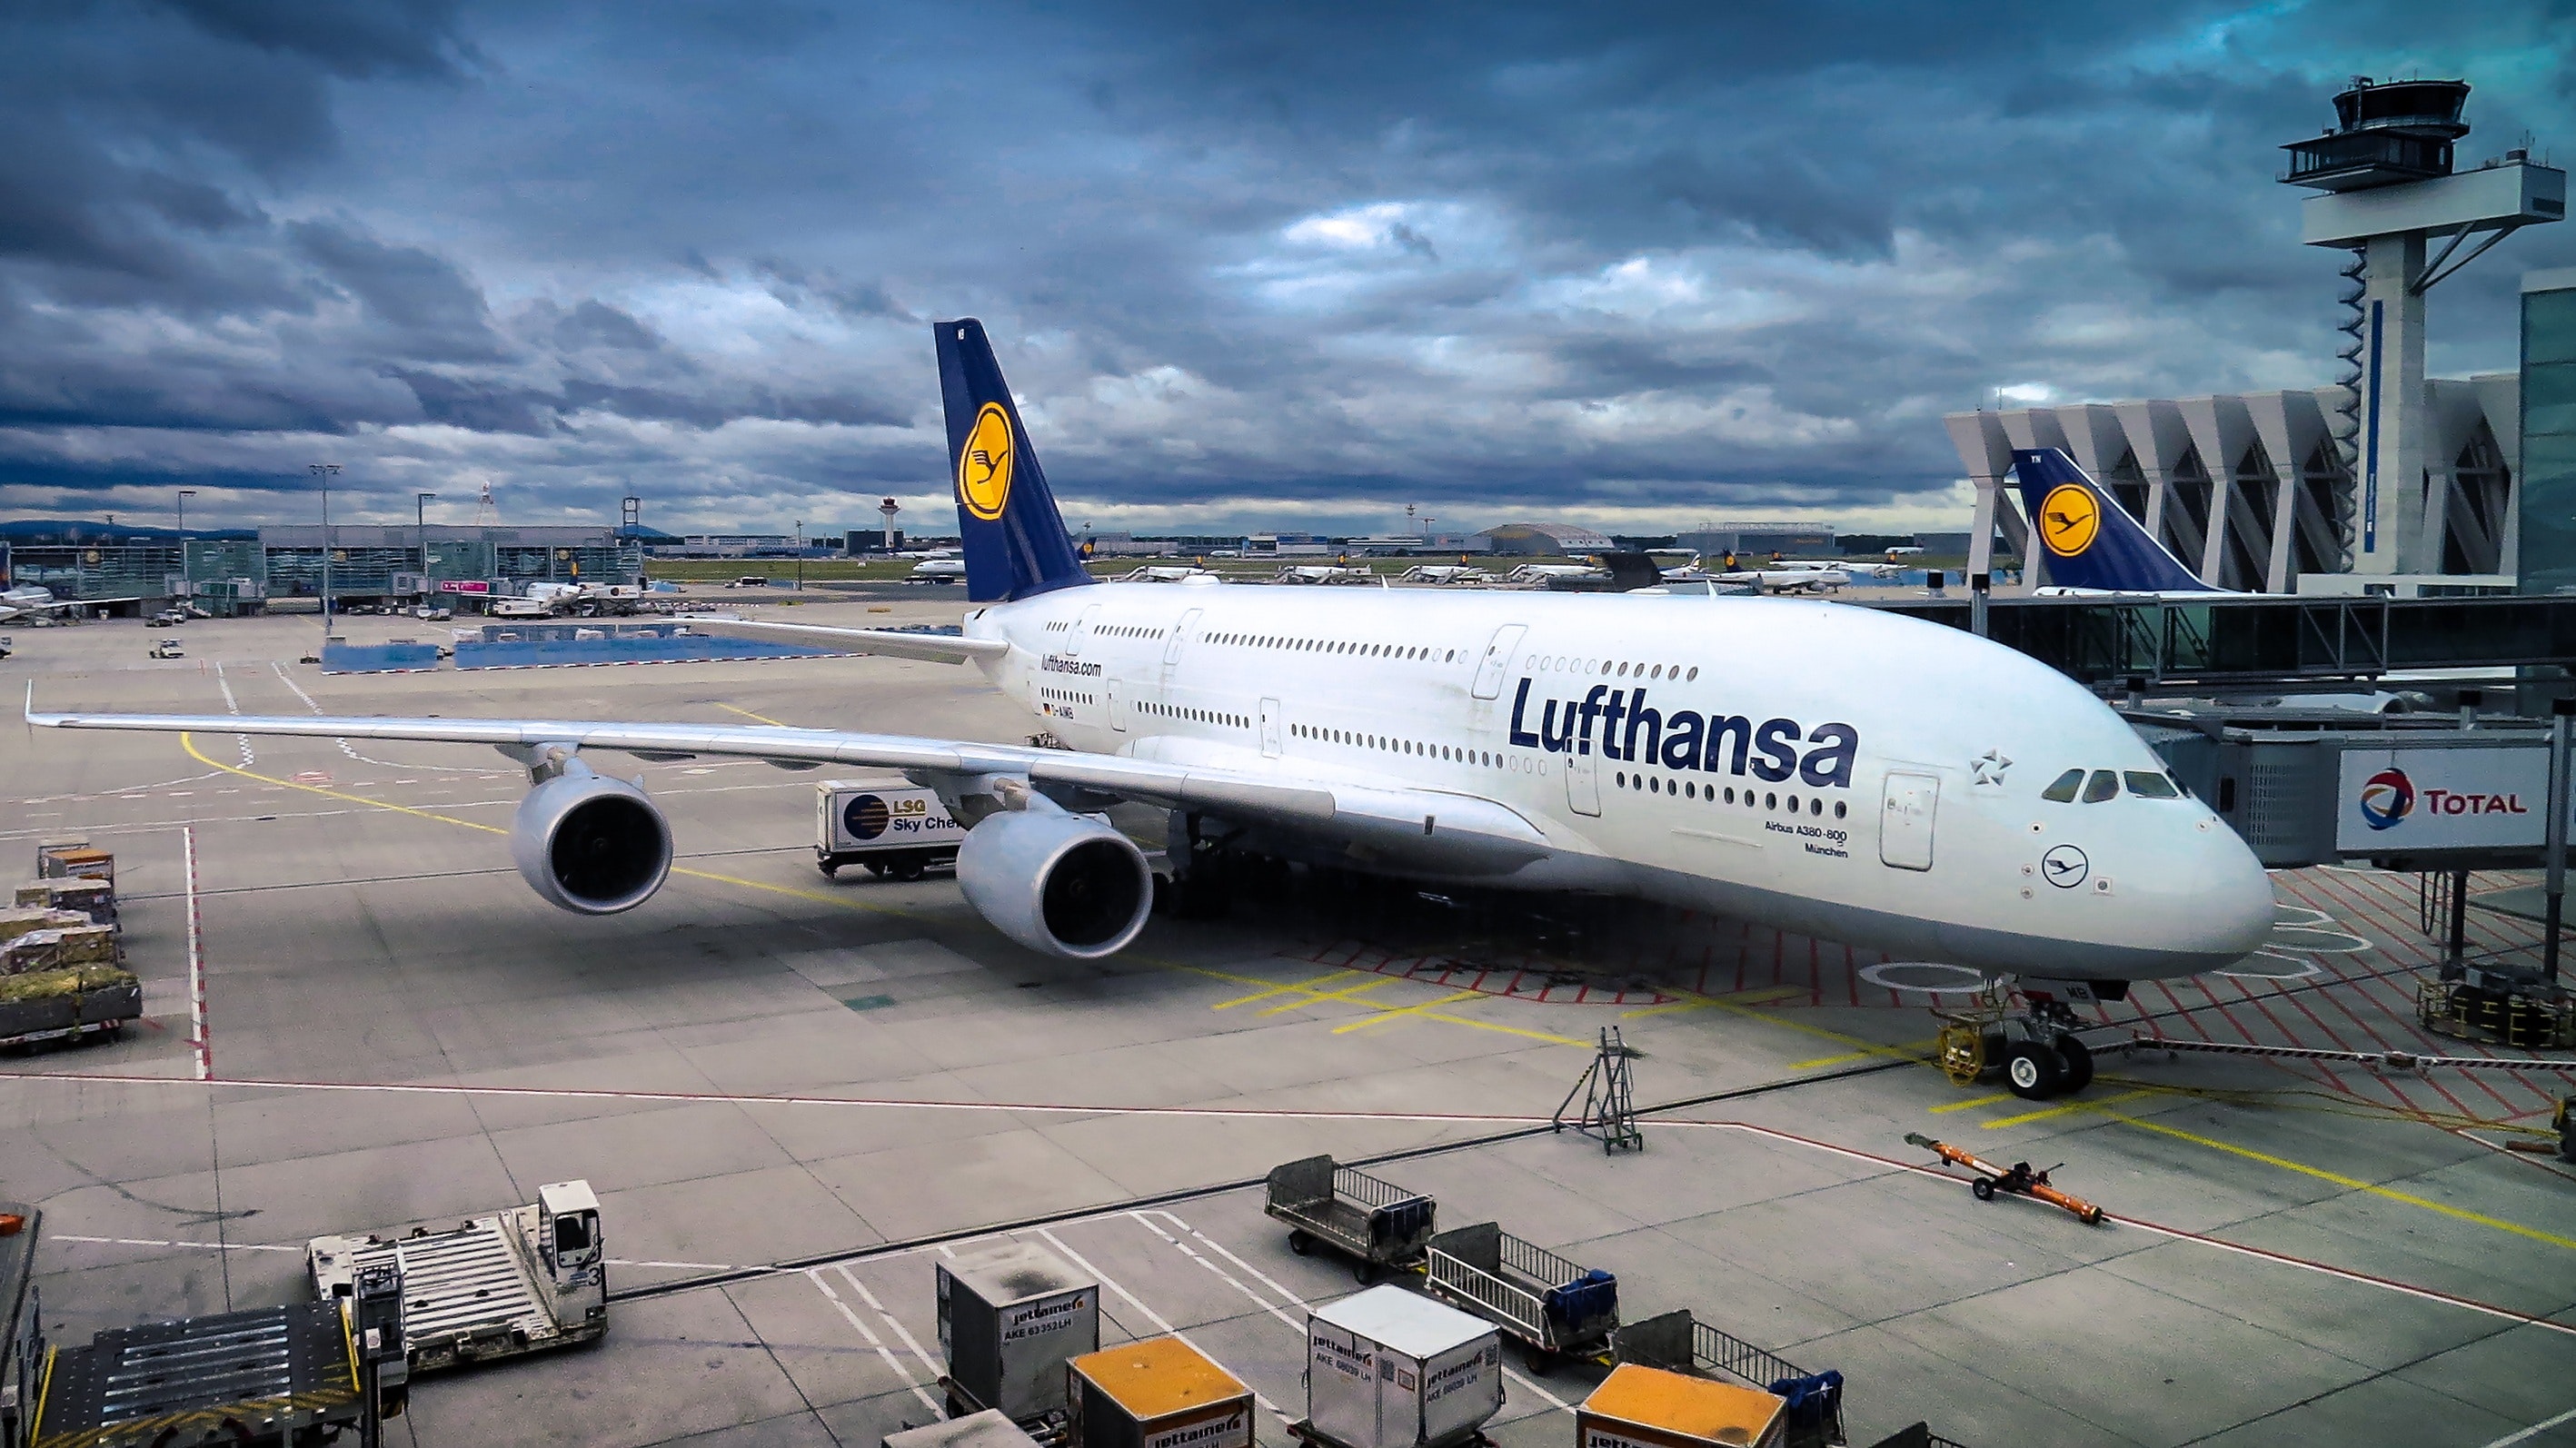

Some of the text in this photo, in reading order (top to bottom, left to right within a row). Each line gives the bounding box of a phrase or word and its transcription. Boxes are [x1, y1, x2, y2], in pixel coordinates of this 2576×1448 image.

[1041, 654, 1101, 678] lufthansa.com
[1509, 678, 1859, 788] Lufthansa
[893, 799, 926, 813] LSG
[2423, 789, 2528, 815] TOTAL
[893, 818, 920, 832] Sky
[1765, 821, 1794, 834] Airbus
[1805, 843, 1848, 858] München
[589, 1267, 601, 1286] 3
[1004, 1328, 1026, 1341] AKE
